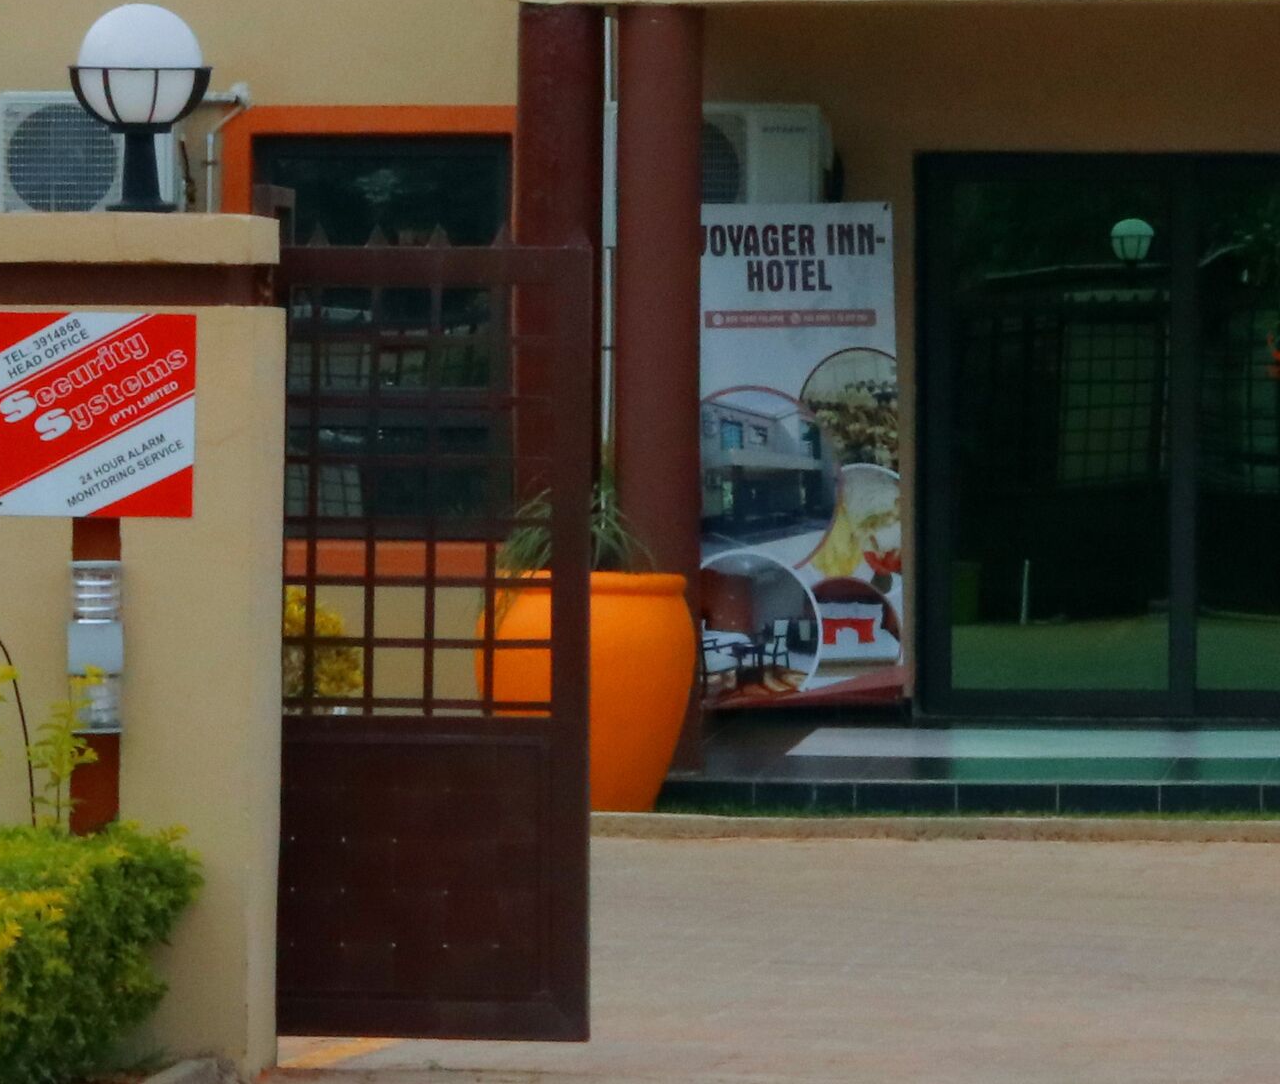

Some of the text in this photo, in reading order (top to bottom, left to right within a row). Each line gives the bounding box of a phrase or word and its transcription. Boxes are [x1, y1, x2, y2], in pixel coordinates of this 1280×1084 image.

[827, 224, 885, 255] INN-
[747, 260, 832, 292] HOTEL
[7, 328, 90, 379] HEAD OFFICE
[34, 349, 188, 441] Systems
[109, 381, 179, 426] (PTY) LIMITED
[66, 439, 185, 508] MONITORING SERVICE
[78, 433, 167, 486] 24 HOUR ALARM
